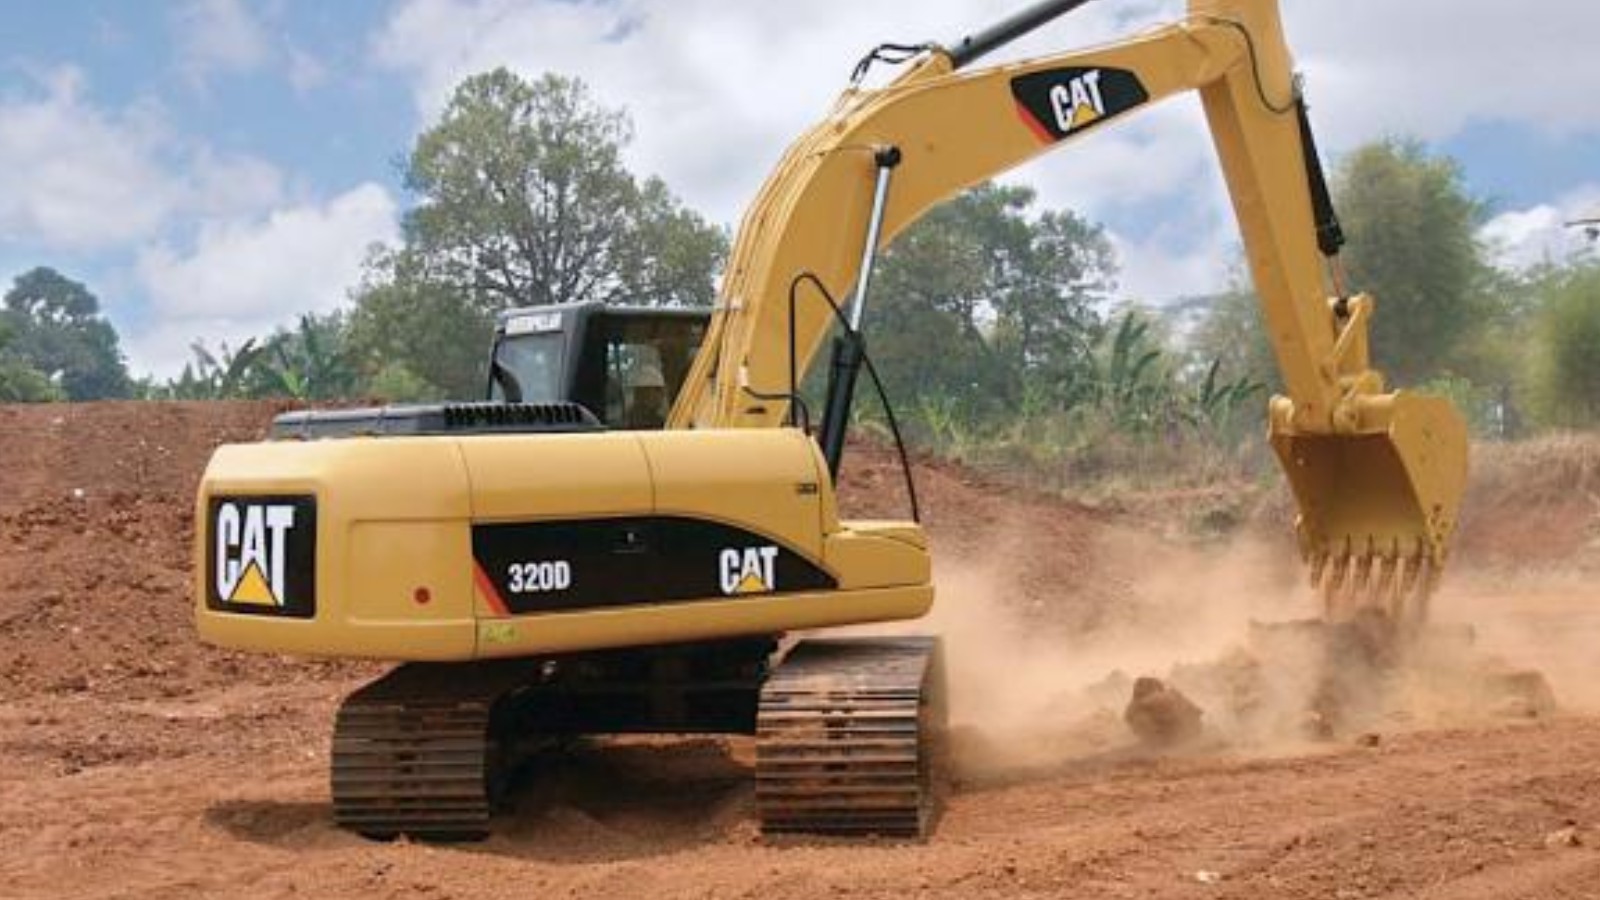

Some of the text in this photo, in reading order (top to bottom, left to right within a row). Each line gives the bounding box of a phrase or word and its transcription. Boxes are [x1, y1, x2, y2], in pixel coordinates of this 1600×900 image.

[1050, 69, 1104, 131] CAT
[217, 502, 294, 606] CAT
[508, 560, 570, 592] 320D
[720, 546, 778, 594] CAT
